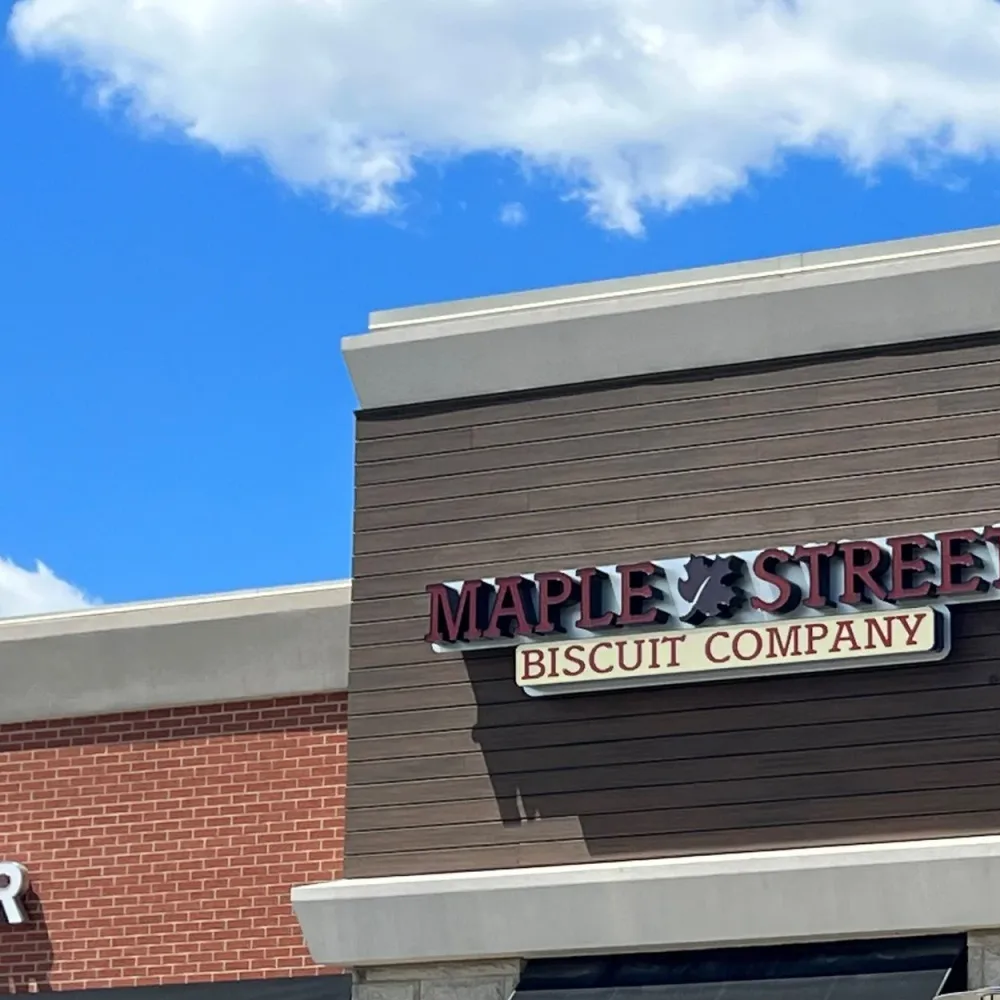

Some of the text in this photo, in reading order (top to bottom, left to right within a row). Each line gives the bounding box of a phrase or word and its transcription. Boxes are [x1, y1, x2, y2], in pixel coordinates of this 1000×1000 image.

[424, 560, 665, 643] MAPLE
[520, 613, 926, 680] BISCUIT COMPANY
